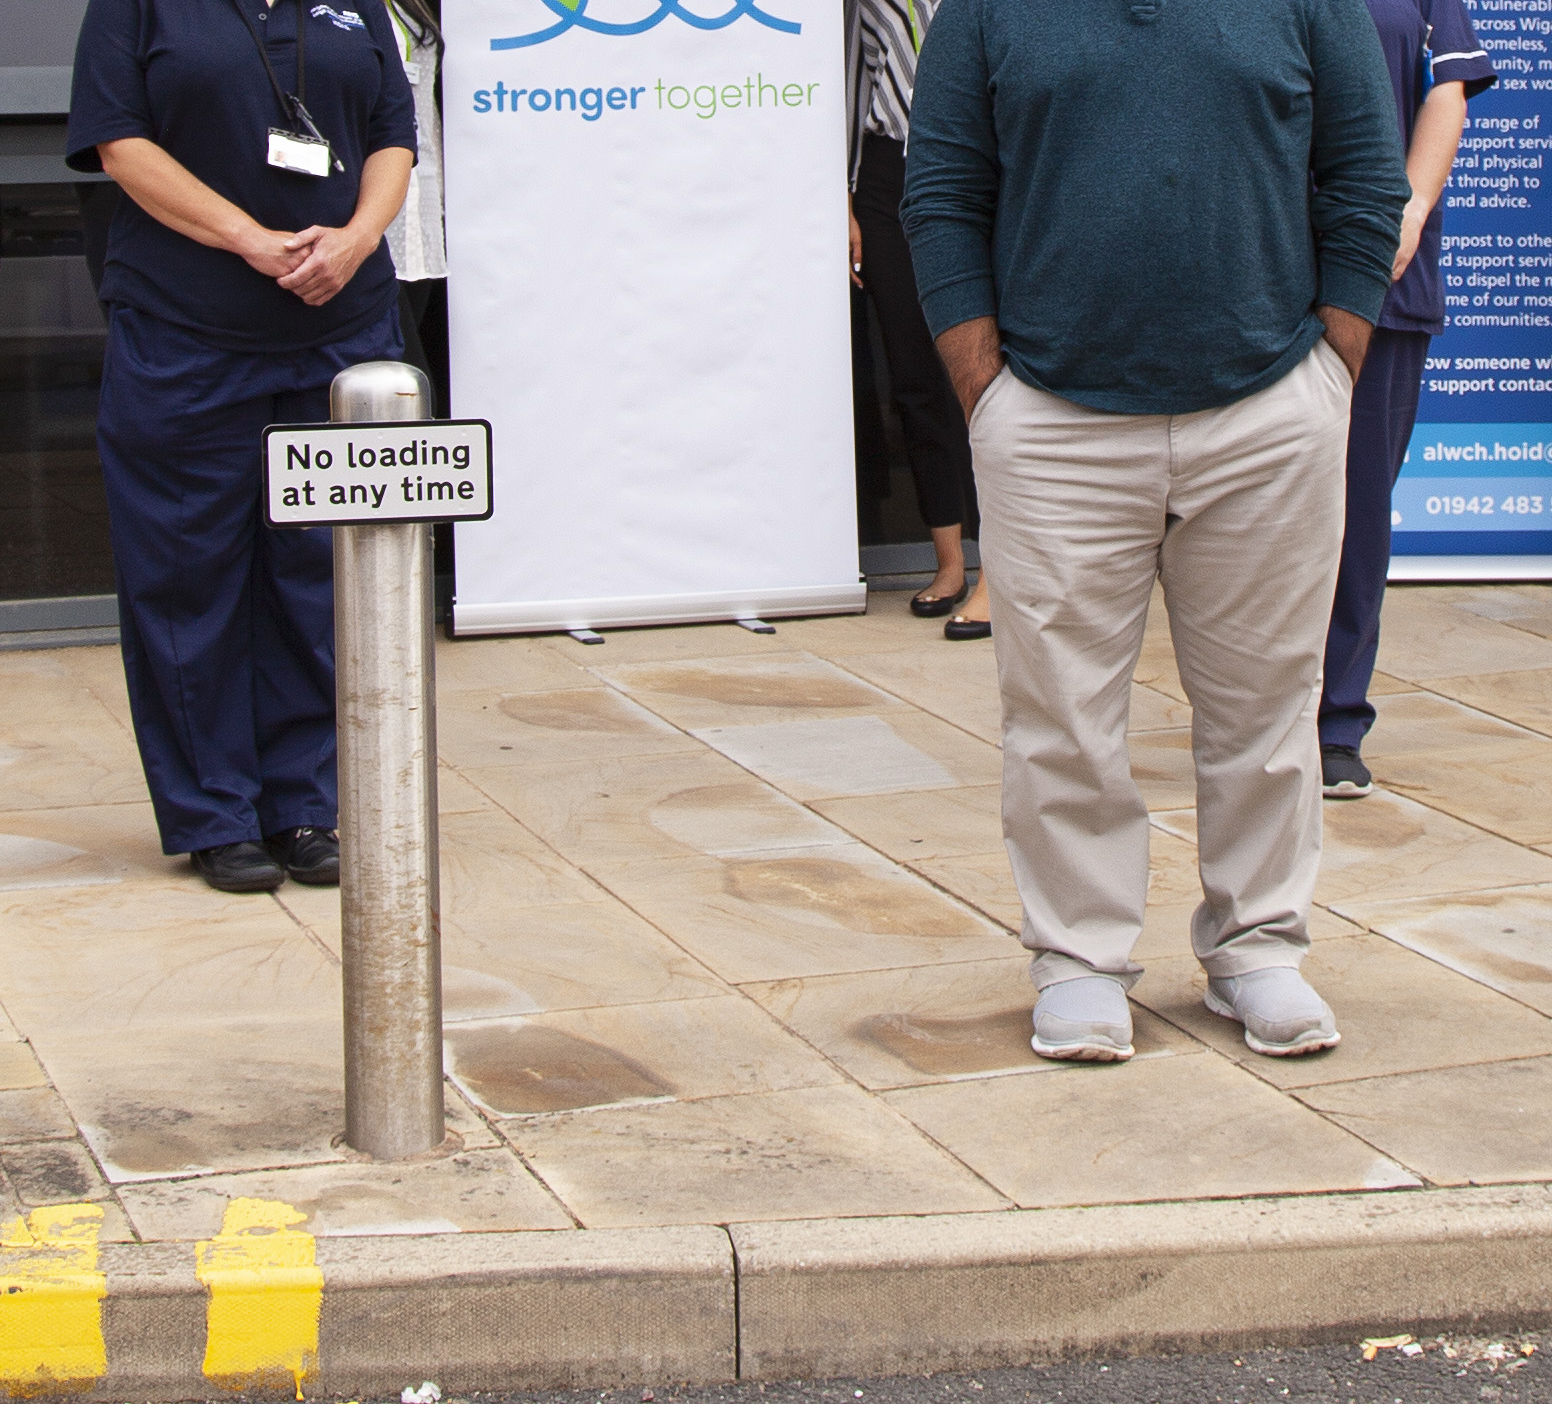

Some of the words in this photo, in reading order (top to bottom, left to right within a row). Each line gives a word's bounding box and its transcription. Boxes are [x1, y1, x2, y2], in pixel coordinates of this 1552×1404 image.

[1473, 19, 1516, 31] across
[1492, 58, 1533, 73] unity,
[1503, 79, 1527, 90] sex
[473, 80, 646, 121] stronger
[654, 72, 820, 119] together
[1475, 118, 1519, 132] range
[1523, 115, 1540, 129] of
[1458, 136, 1515, 151] support
[1452, 155, 1479, 168] eral
[1483, 155, 1542, 171] physical
[1458, 175, 1519, 191] through
[1524, 176, 1540, 188] to
[1447, 194, 1475, 207] and
[1479, 194, 1531, 208] advice.
[1441, 234, 1493, 250] gnpost
[1497, 235, 1513, 247] to
[1456, 254, 1514, 269] support
[1446, 274, 1463, 286] to
[1467, 273, 1511, 289] dispel
[1515, 274, 1540, 287] the
[1473, 293, 1489, 306] of
[1493, 295, 1519, 306] our
[1425, 357, 1451, 370] ow
[1455, 357, 1531, 370] someone
[1429, 378, 1495, 395] support
[286, 443, 333, 470] No
[348, 440, 470, 469] loading
[282, 481, 316, 506] at
[329, 483, 387, 508] any
[400, 476, 475, 502] time
[1426, 496, 1494, 514] 01942
[1500, 496, 1543, 514] 483
